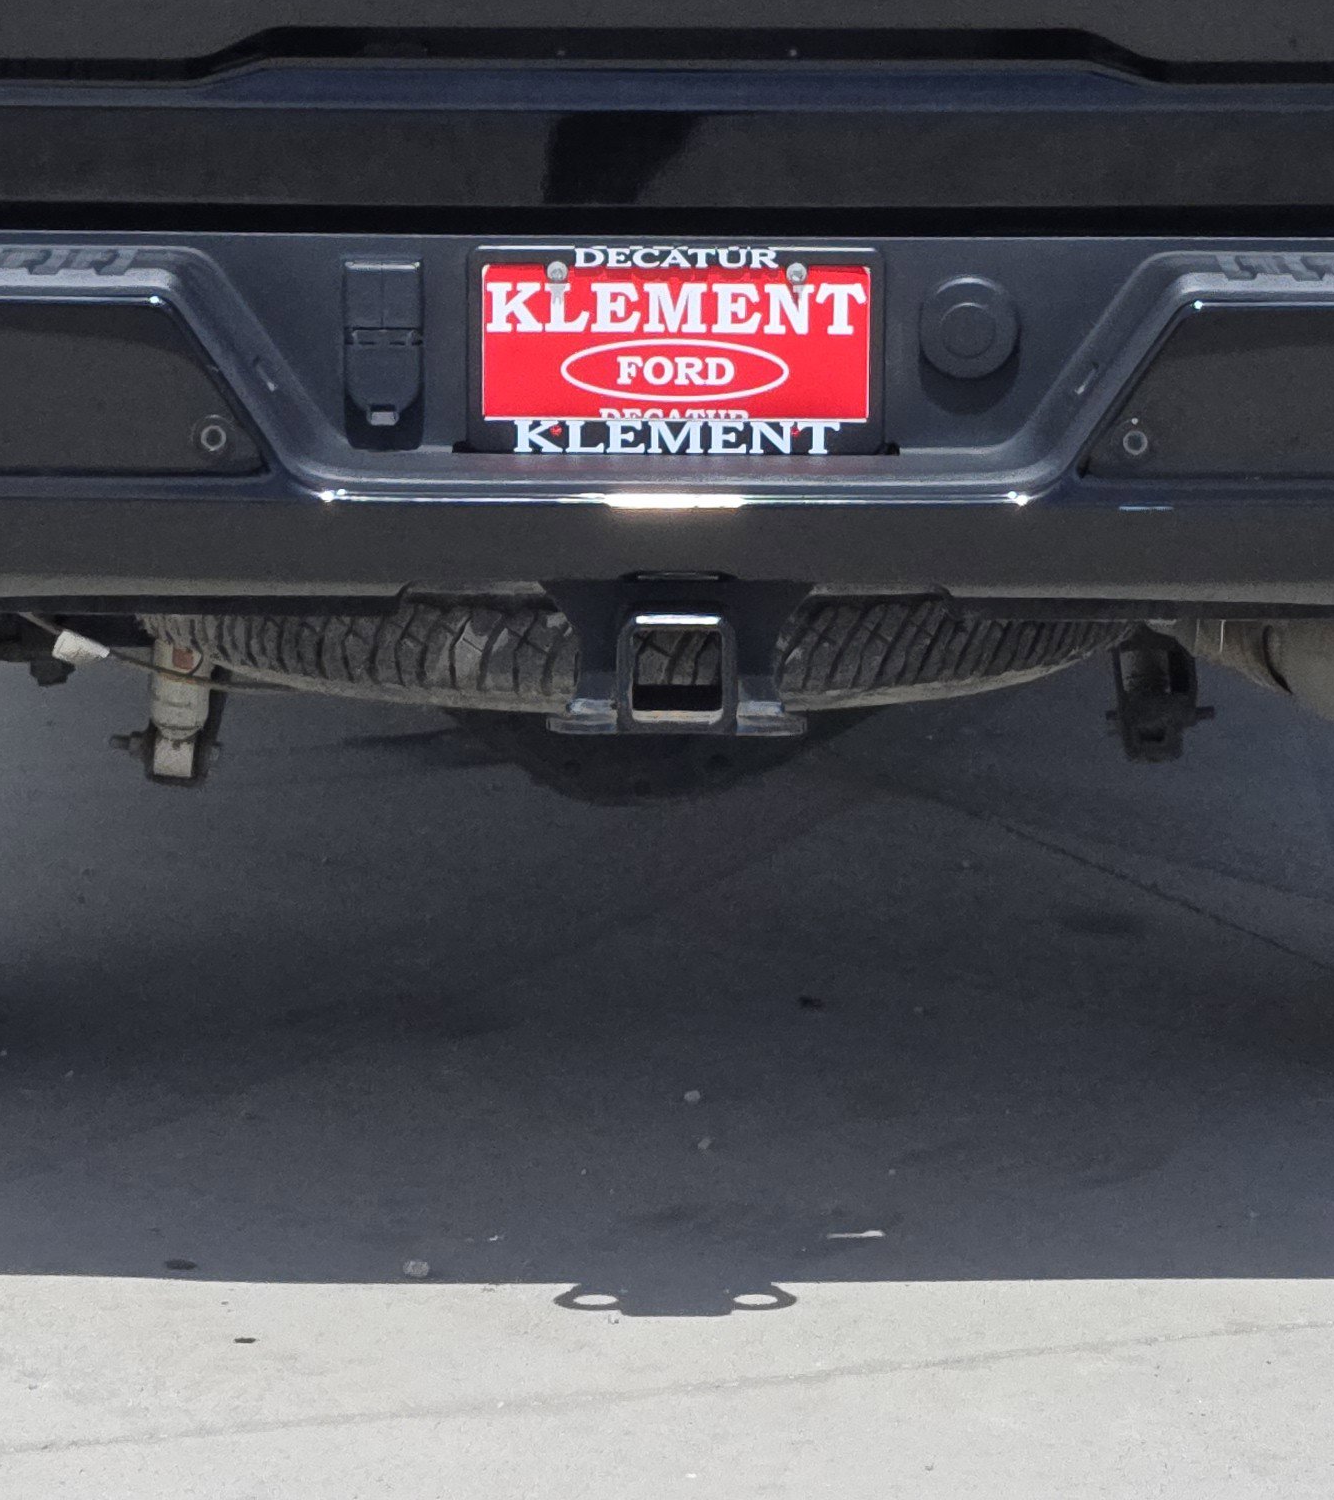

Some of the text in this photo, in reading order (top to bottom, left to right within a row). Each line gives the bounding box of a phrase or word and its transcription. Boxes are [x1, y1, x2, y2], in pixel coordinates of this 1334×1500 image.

[574, 247, 779, 270] DECATUR
[485, 281, 867, 336] KLEMENT
[616, 355, 736, 387] FORD
[513, 419, 841, 455] KLEMENT
